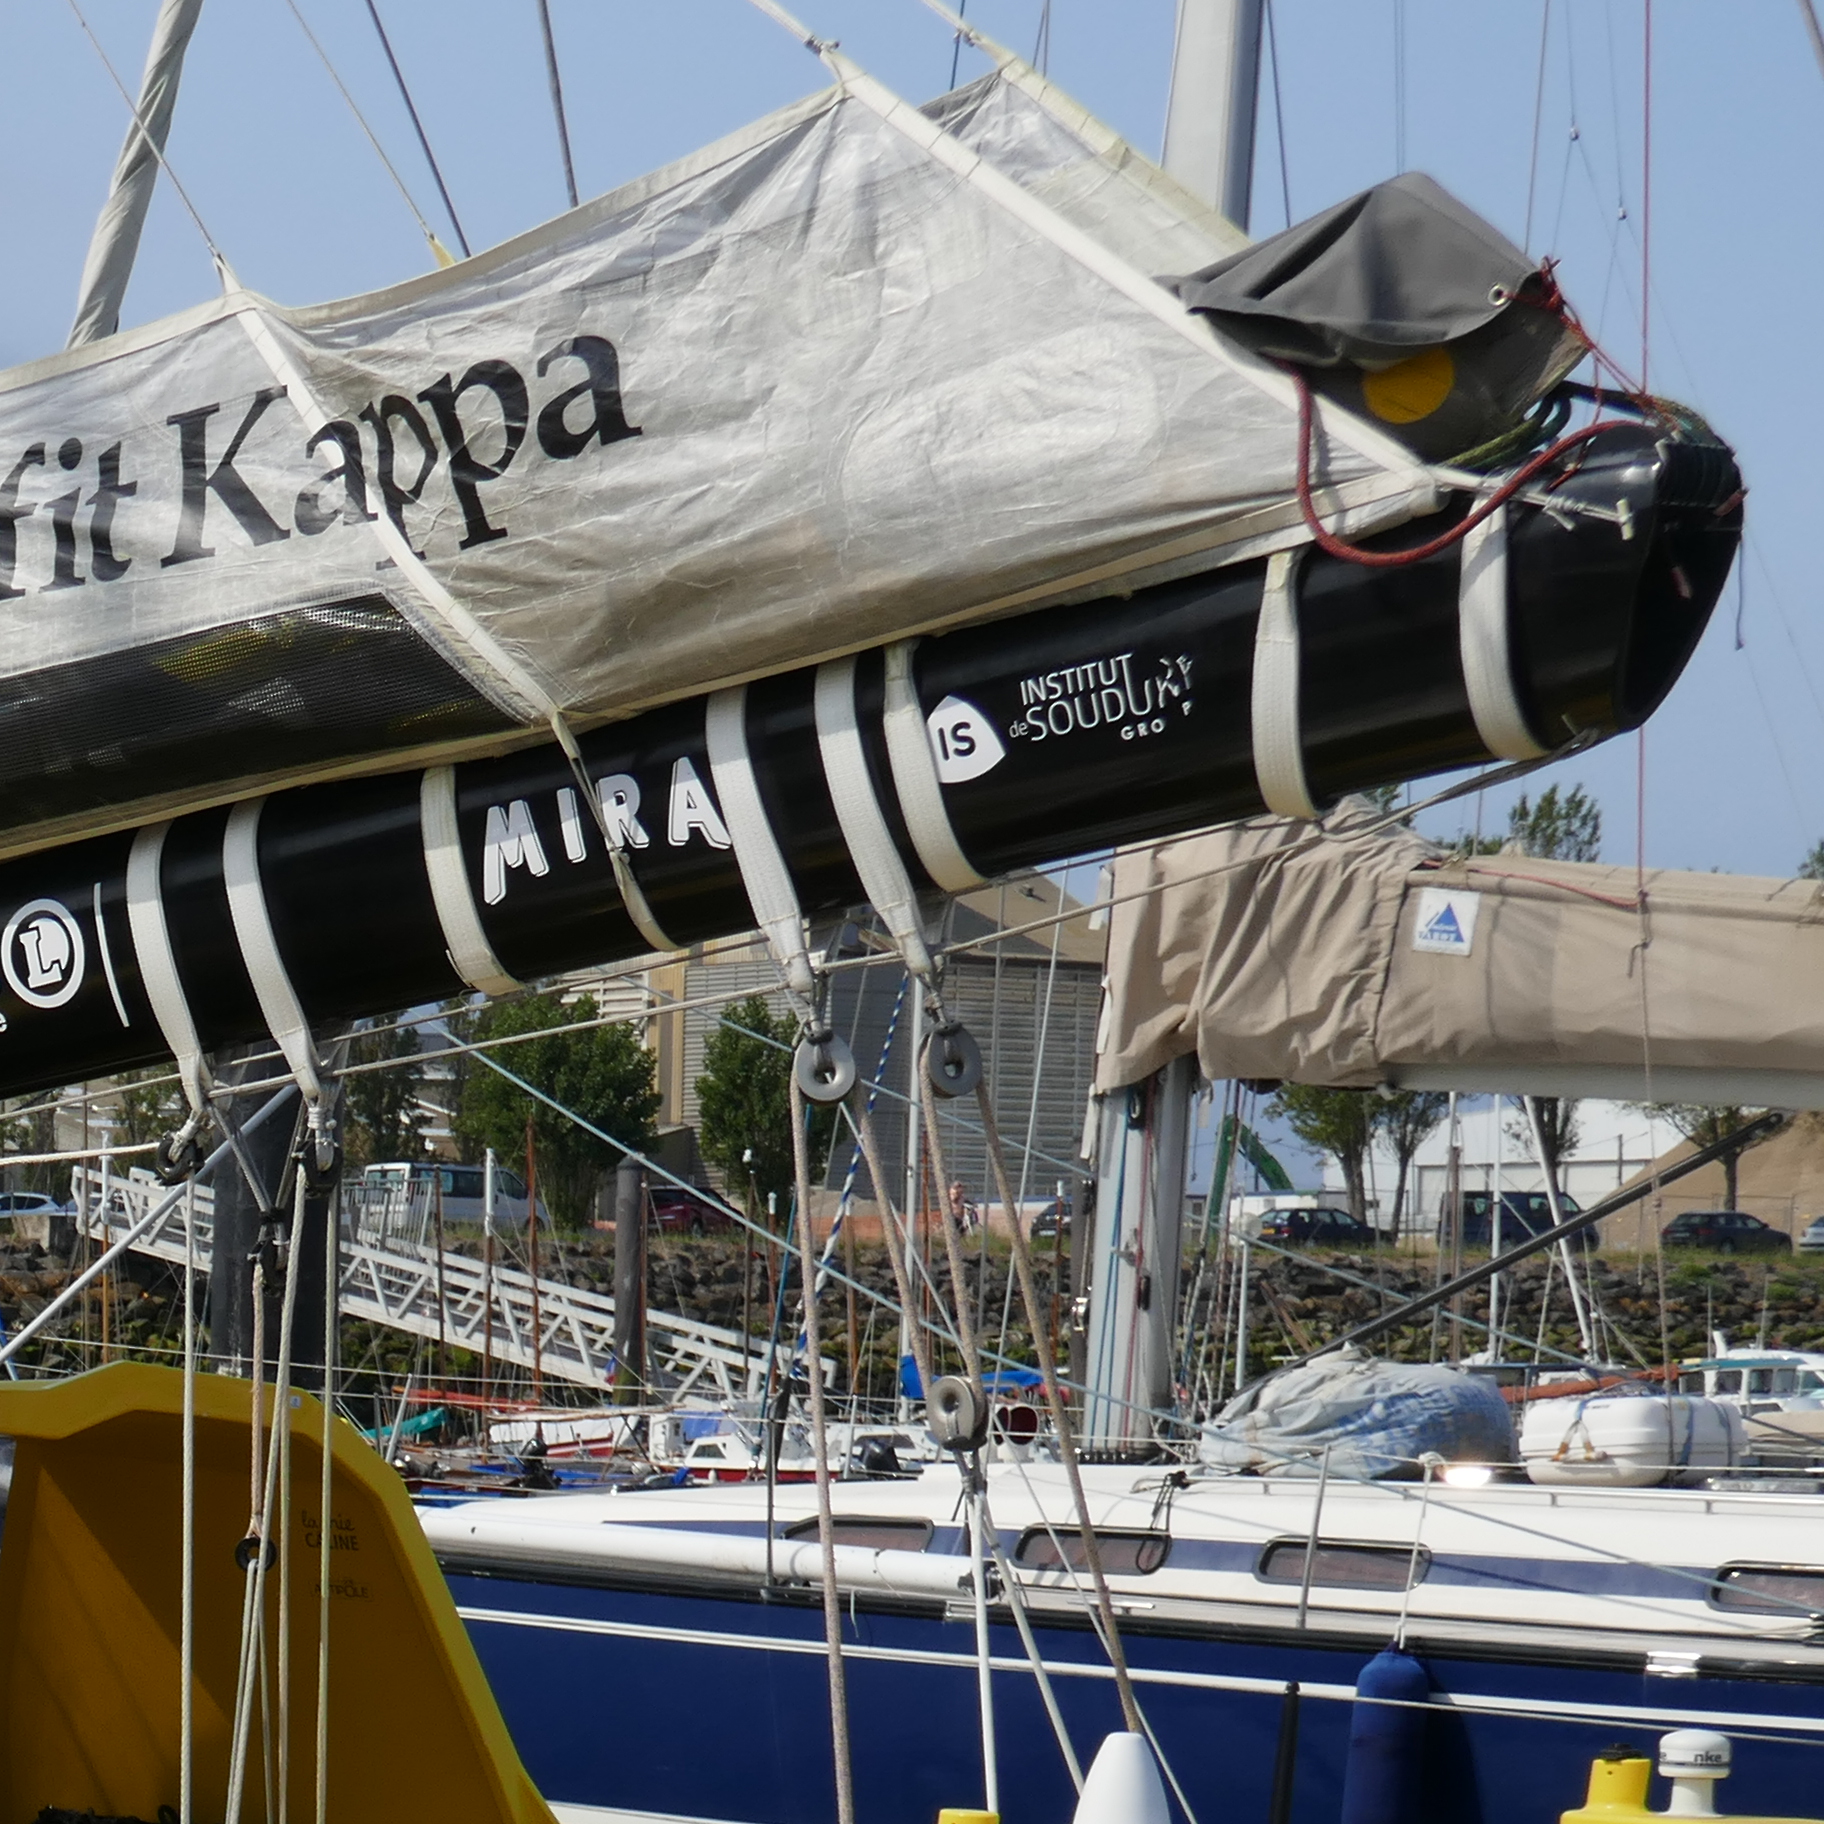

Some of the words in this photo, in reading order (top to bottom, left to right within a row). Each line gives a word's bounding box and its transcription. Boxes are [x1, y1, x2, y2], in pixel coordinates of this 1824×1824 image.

[160, 334, 643, 569] Kappa
[1019, 653, 1133, 706] INSTITUT
[938, 721, 977, 761] IS
[1694, 1751, 1722, 1763] nke
